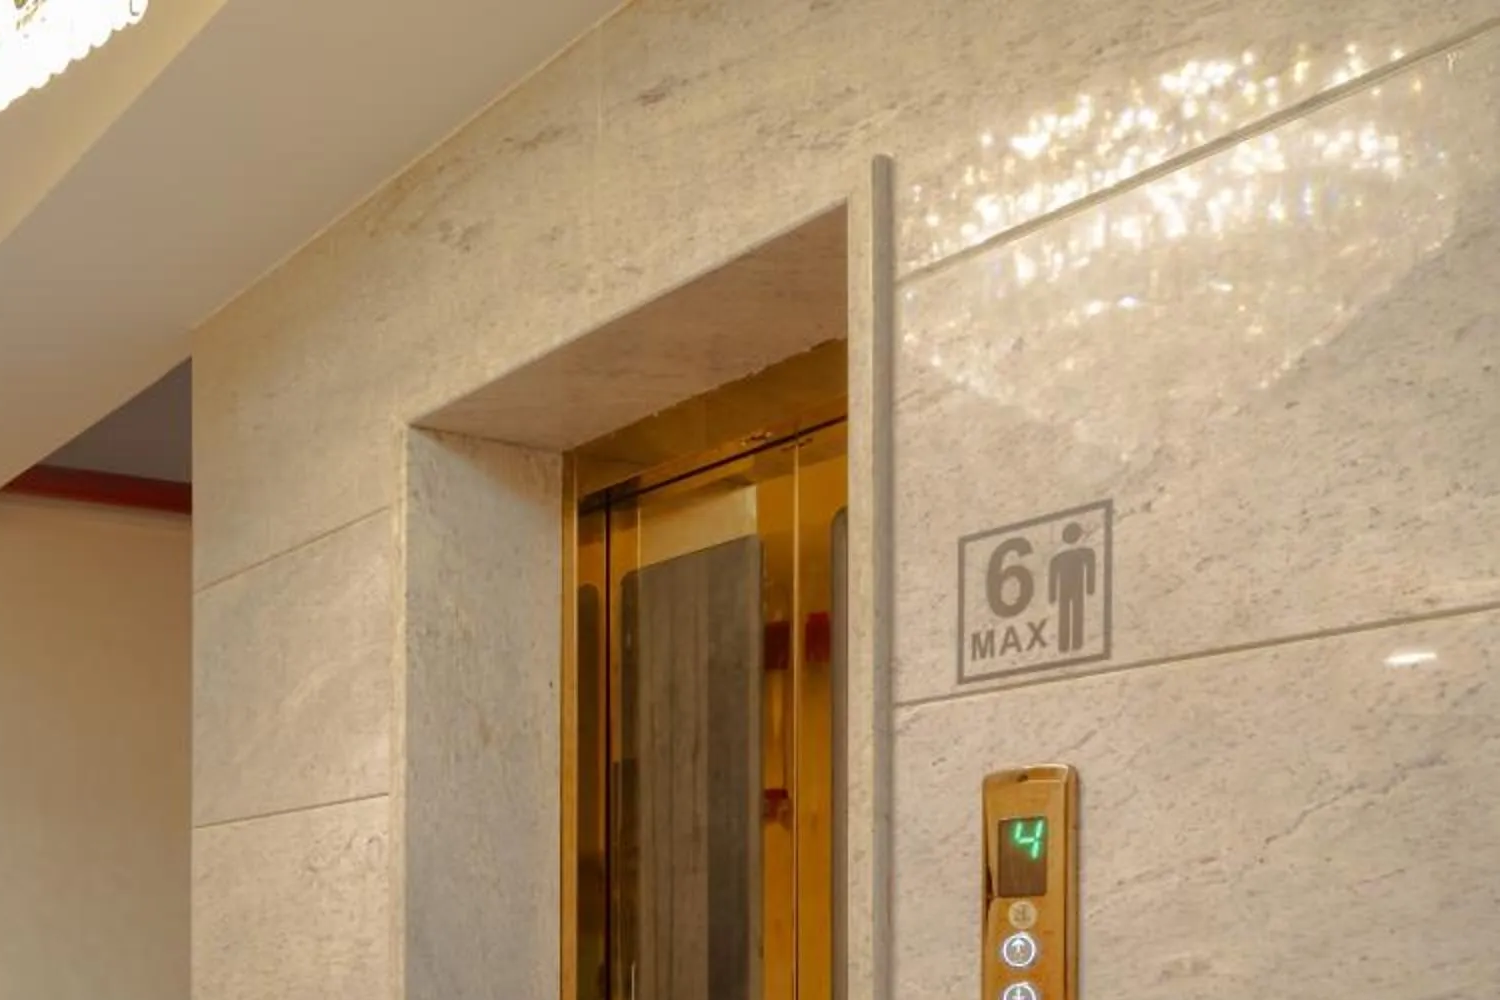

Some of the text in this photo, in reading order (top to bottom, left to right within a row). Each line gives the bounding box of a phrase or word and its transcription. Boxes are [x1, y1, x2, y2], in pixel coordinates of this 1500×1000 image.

[986, 537, 1034, 618] 6
[971, 618, 1048, 661] MAX
[1013, 819, 1044, 860] 4
